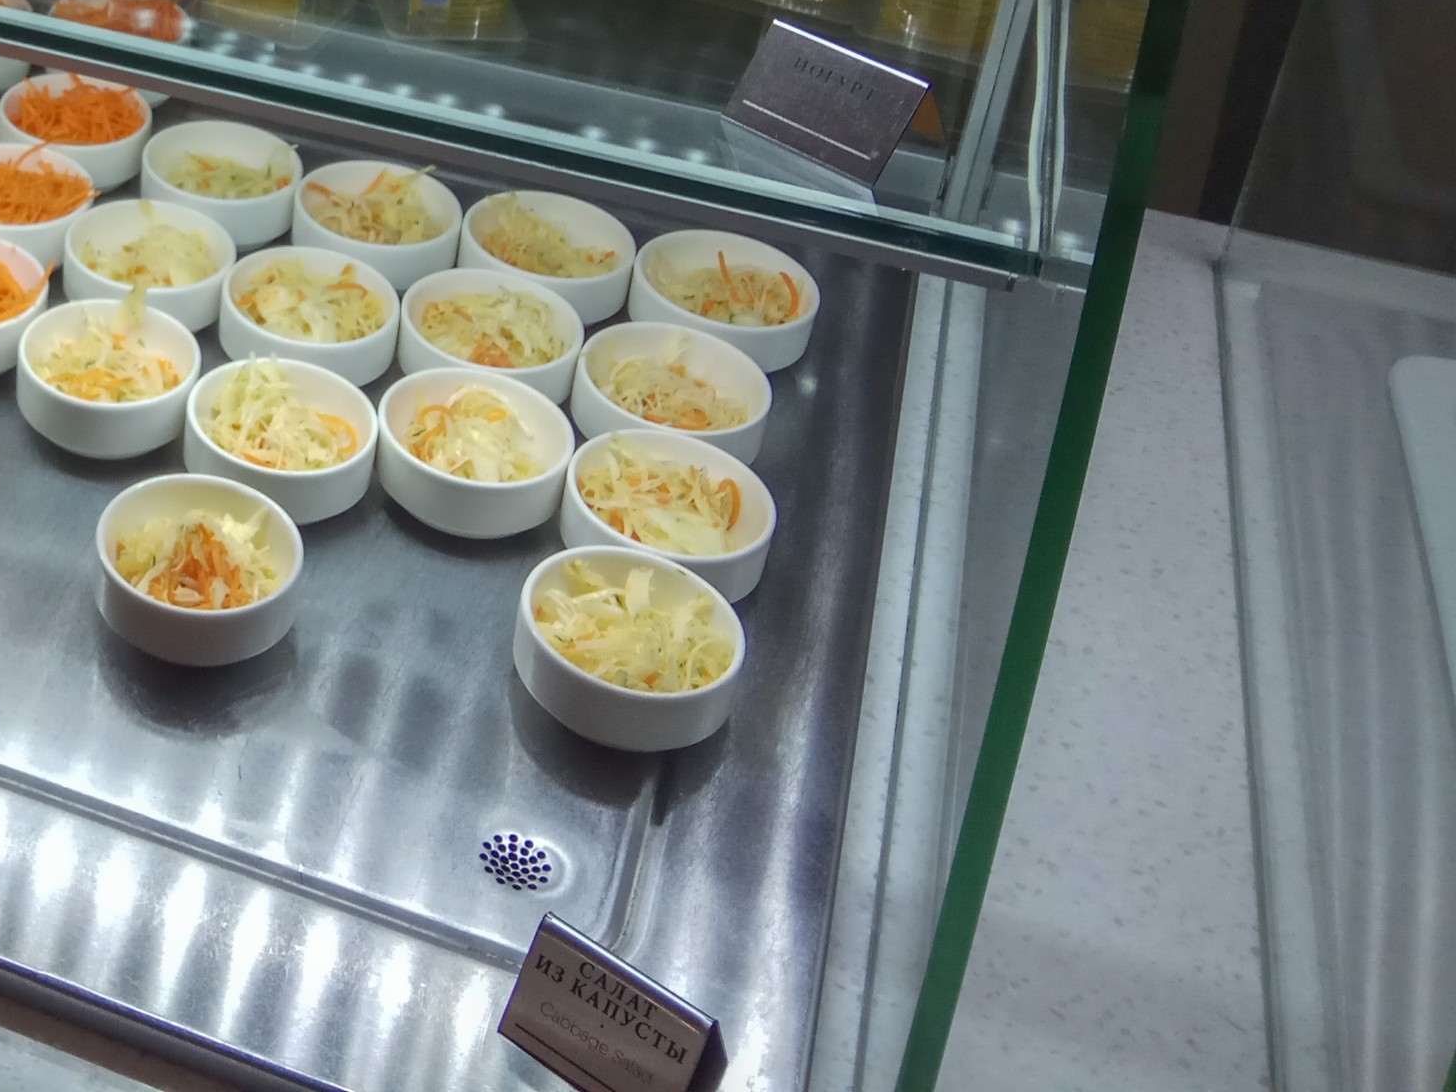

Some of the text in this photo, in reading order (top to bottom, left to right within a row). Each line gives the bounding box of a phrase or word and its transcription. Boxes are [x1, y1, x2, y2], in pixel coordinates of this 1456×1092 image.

[534, 954, 689, 1065] ИЗ КАПУСТЫ
[578, 961, 659, 1021] САЛАТ
[540, 1001, 610, 1056] Cabbage
